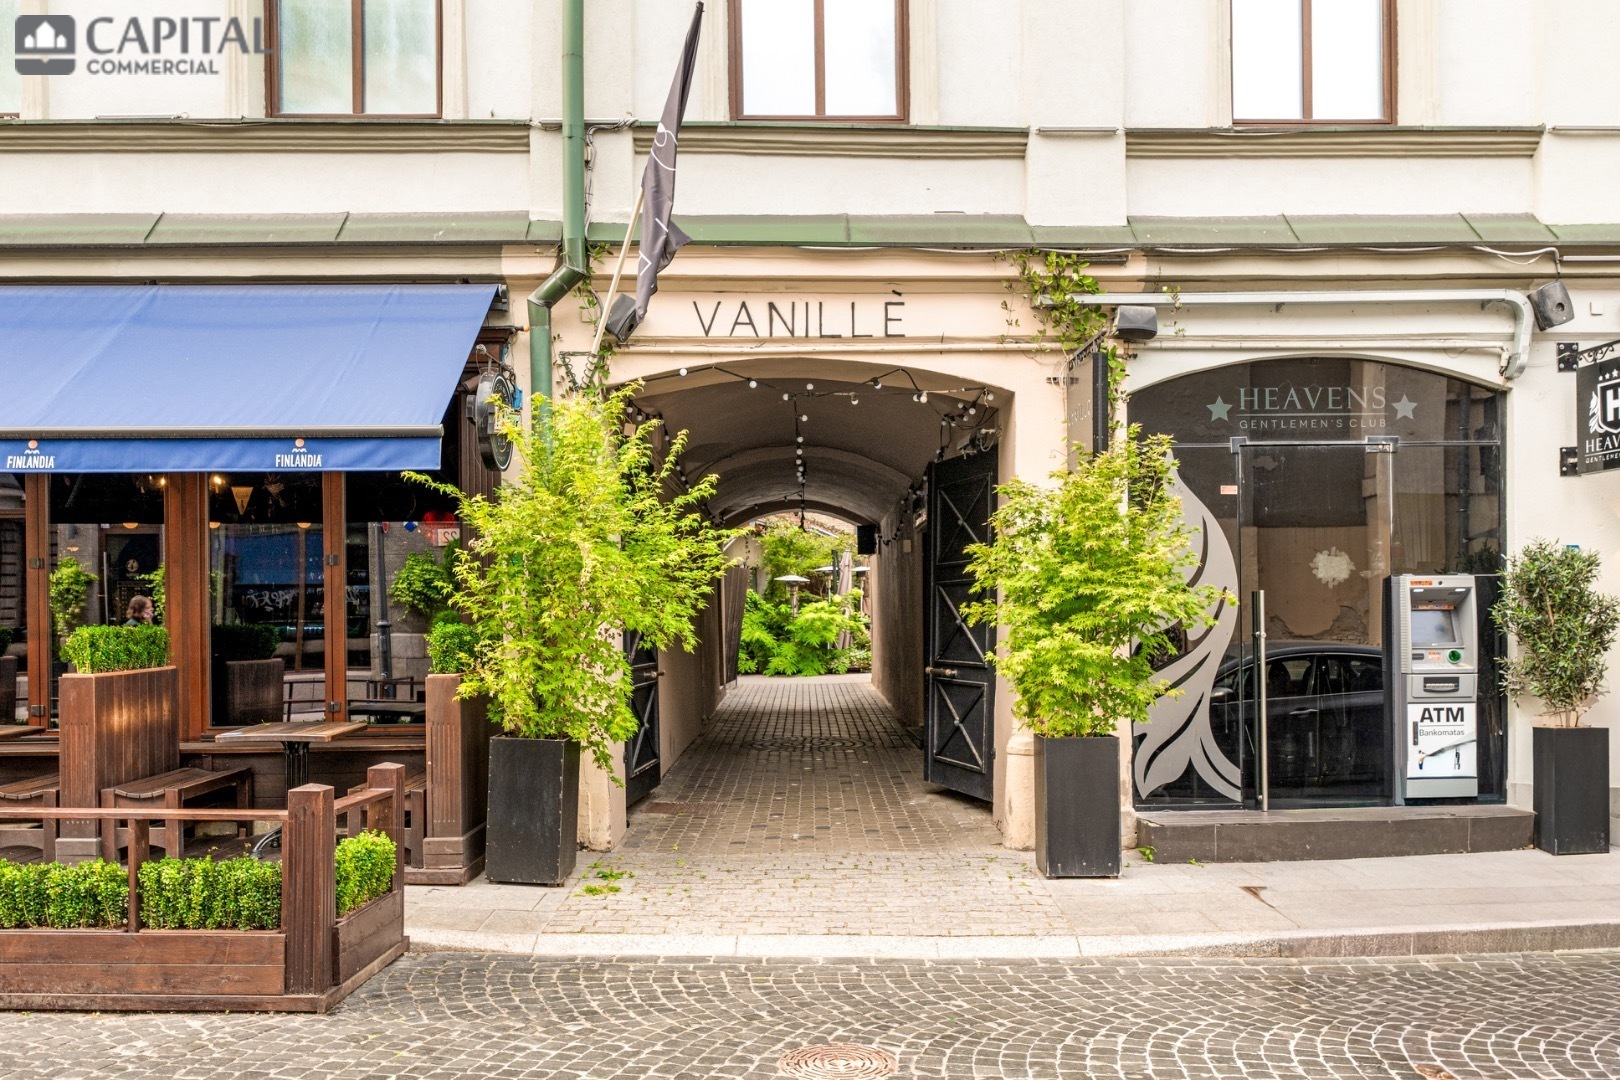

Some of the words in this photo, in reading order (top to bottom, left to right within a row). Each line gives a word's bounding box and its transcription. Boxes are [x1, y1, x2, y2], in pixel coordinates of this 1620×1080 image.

[1239, 386, 1386, 410] HEAVENS
[1239, 419, 1343, 429] GENTLEMEN'S
[1349, 418, 1387, 428] CLUB
[6, 455, 55, 469] FINLANDIA
[275, 454, 322, 468] FINLANDIA
[1585, 452, 1620, 464] GENTLEME
[1420, 707, 1465, 723] ATM
[1419, 729, 1465, 737] Bankomatas
